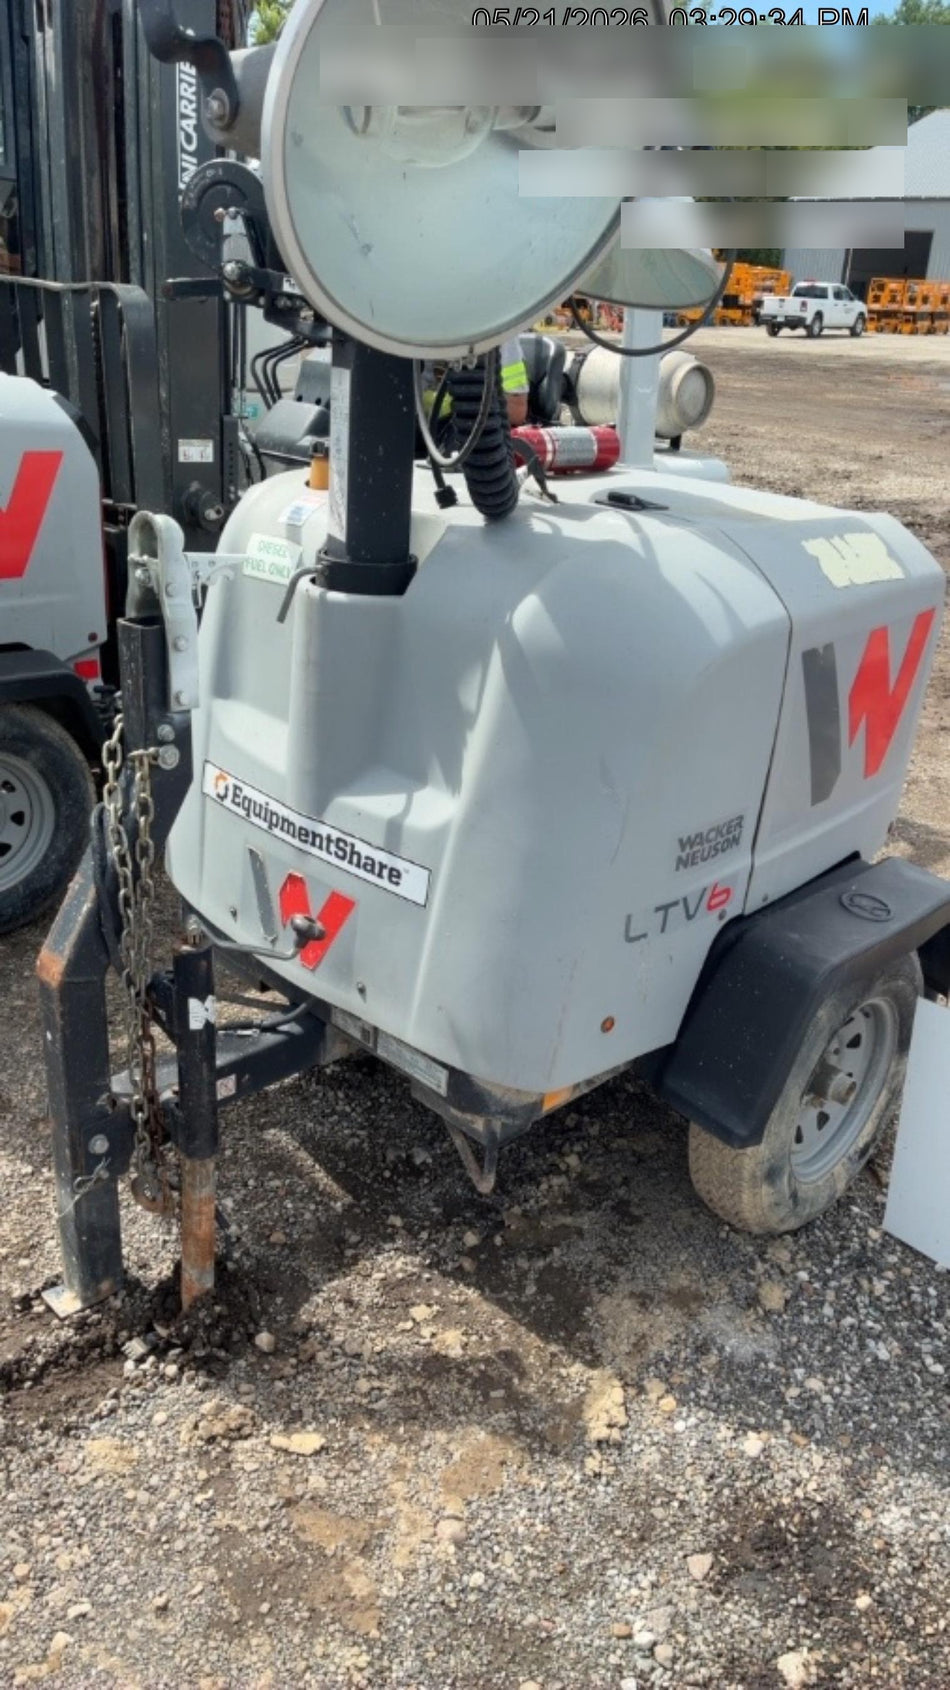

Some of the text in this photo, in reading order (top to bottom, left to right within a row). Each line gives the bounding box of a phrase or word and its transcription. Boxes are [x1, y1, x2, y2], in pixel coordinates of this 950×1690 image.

[178, 61, 198, 202] NICARRIE
[230, 783, 403, 886] EquipmentShare
[675, 832, 742, 872] NEUSON
[678, 814, 744, 853] WACKER
[624, 881, 732, 944] LTV6
